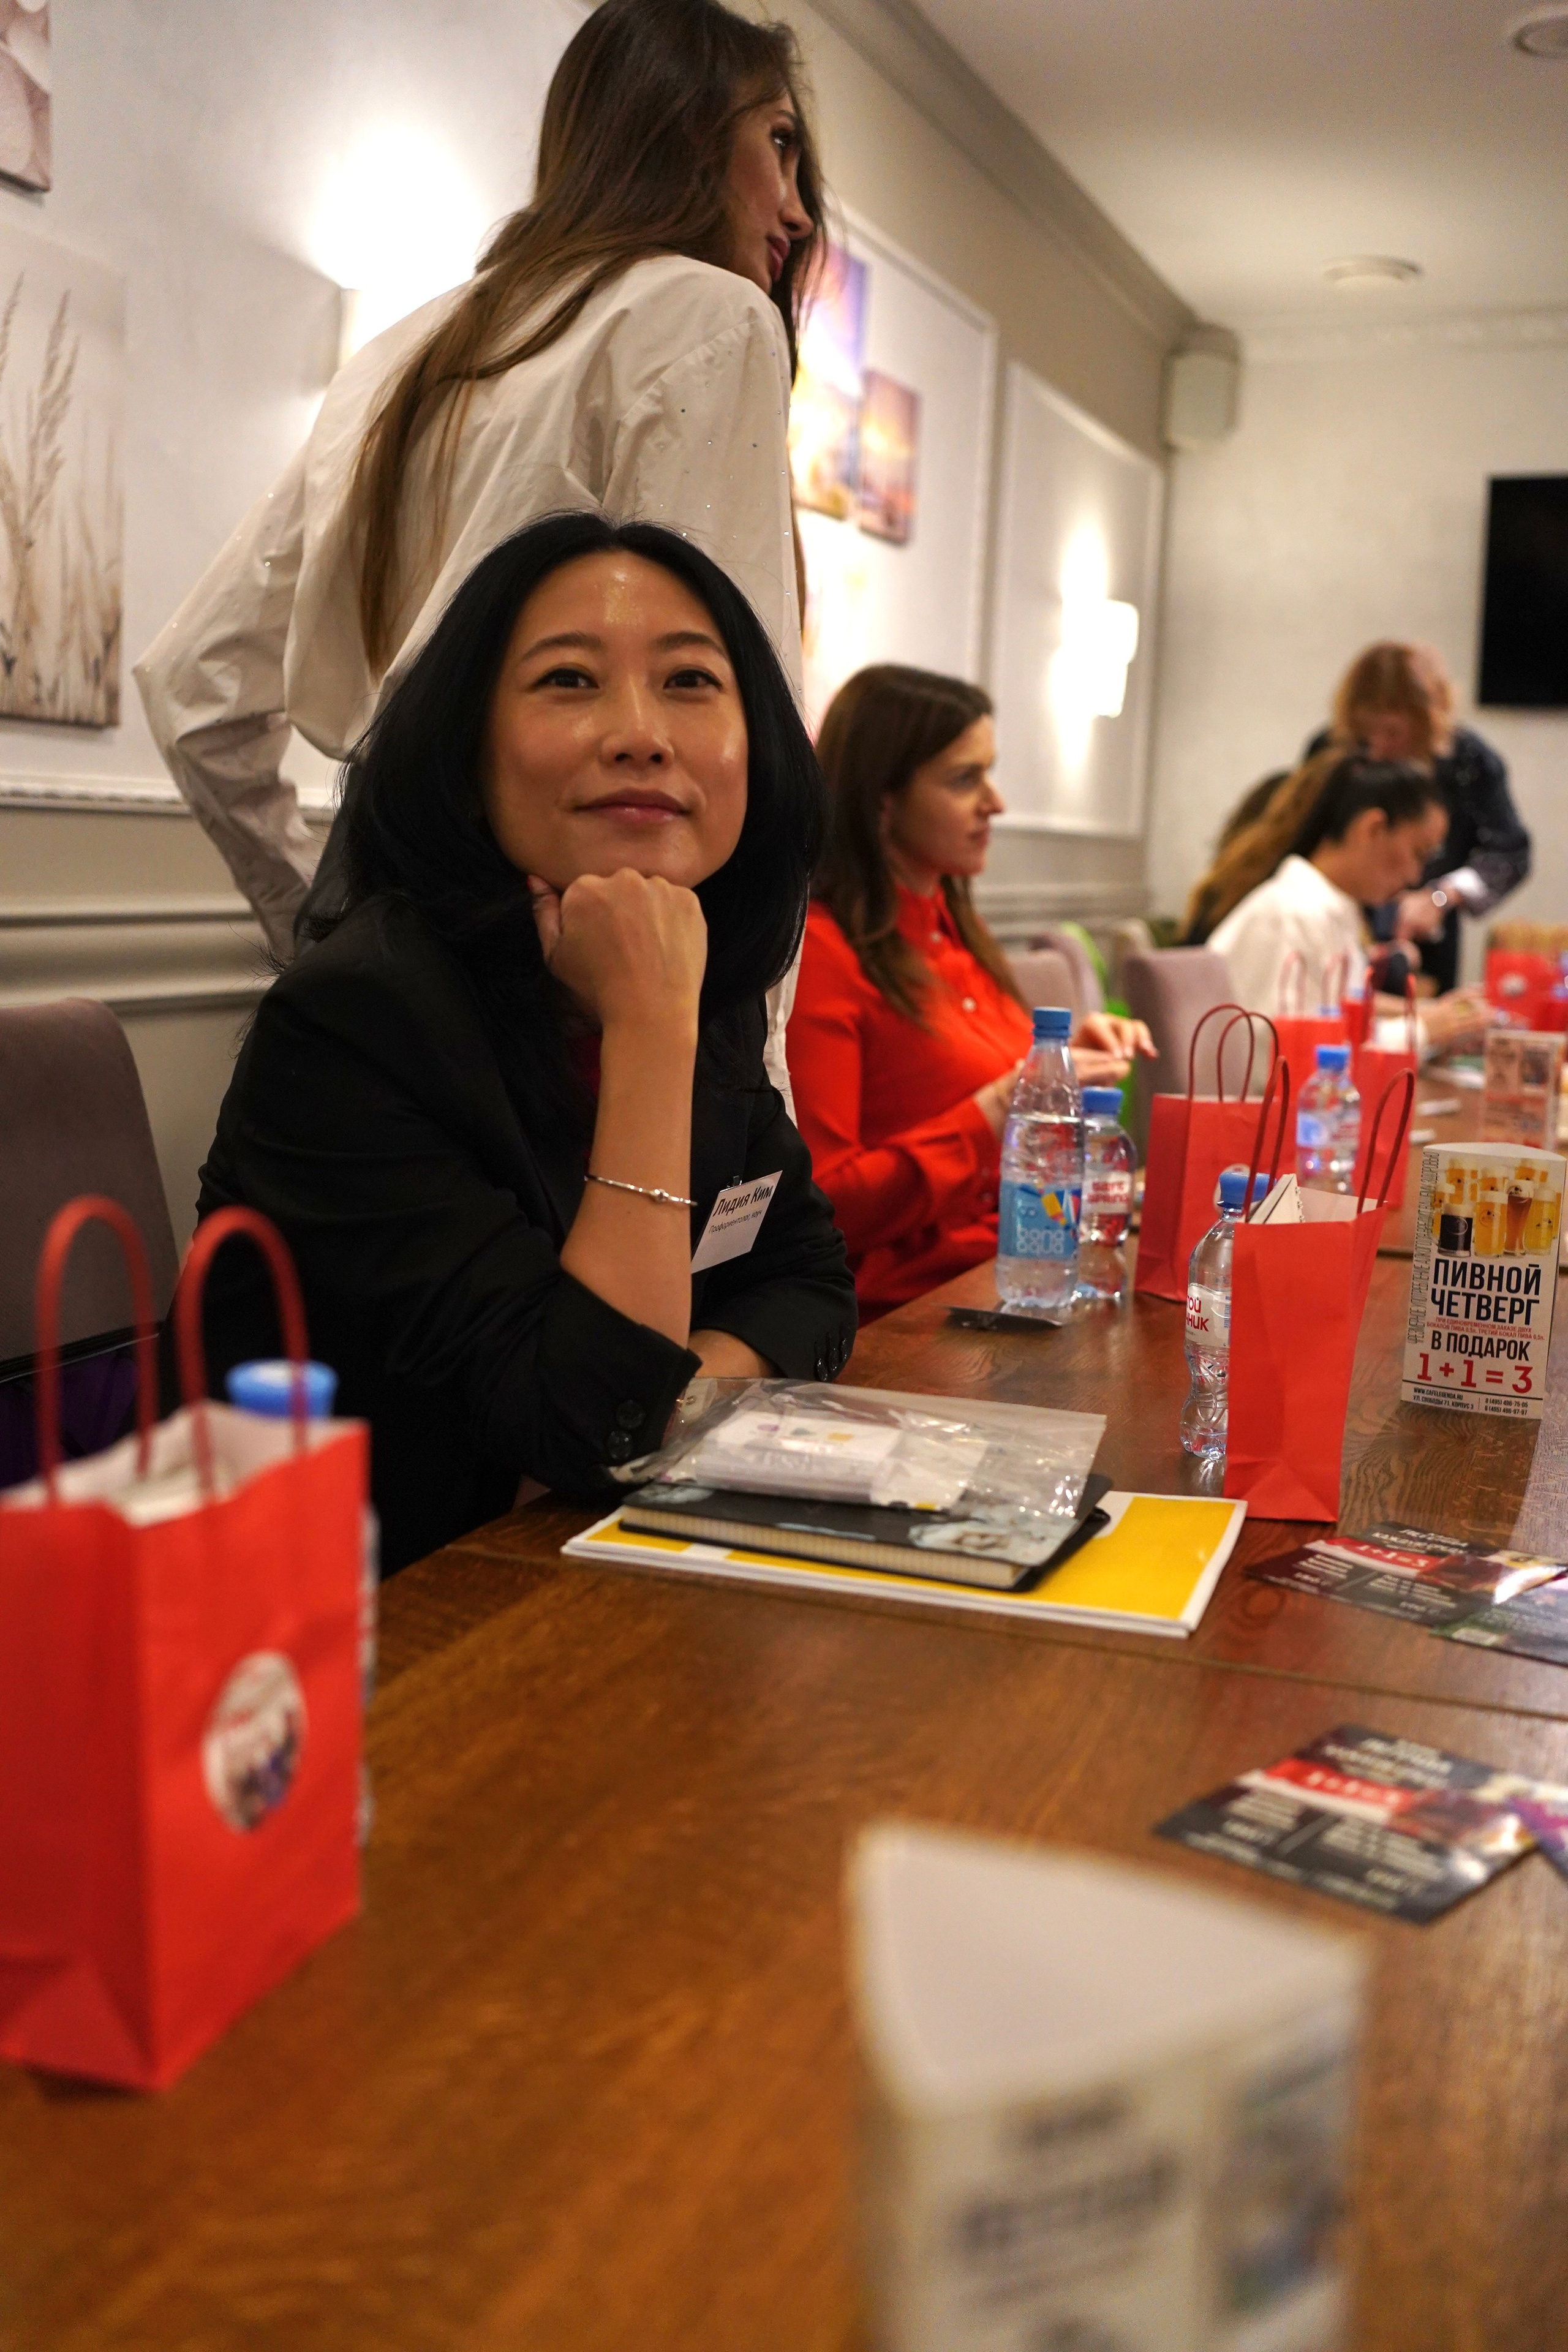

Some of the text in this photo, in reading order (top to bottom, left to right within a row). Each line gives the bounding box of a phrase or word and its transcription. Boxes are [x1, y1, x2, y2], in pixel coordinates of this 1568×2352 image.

[712, 1186, 774, 1217] Лидия Ким
[1433, 1258, 1541, 1295] ПИВНОЙ
[1431, 1288, 1540, 1325] ЧЕТВЕРГ
[1431, 1330, 1531, 1362] В ПОДАРОК
